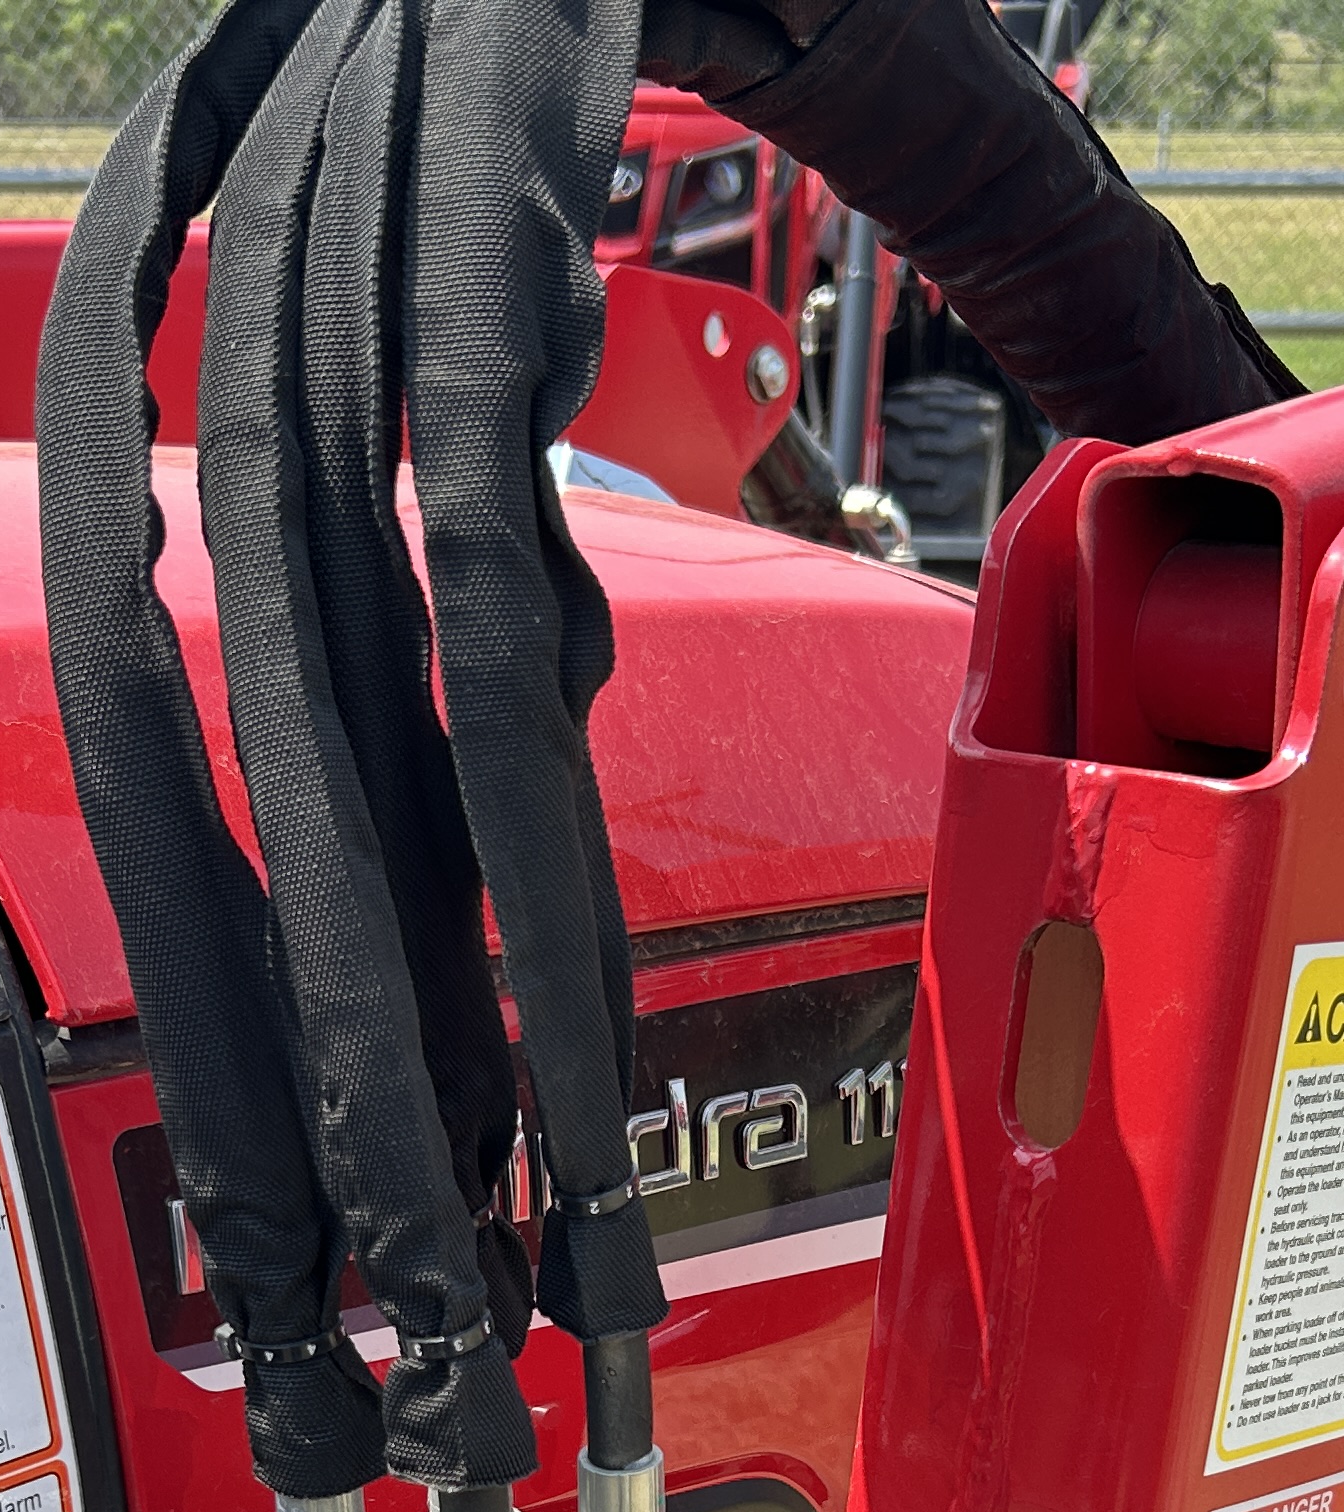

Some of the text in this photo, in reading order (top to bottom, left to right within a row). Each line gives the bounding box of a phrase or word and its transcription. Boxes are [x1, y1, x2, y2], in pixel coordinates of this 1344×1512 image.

[1296, 1073, 1317, 1088] Read
[1316, 1071, 1333, 1086] and
[1276, 1182, 1307, 1200] Operate
[1307, 1180, 1320, 1193] the
[1319, 1176, 1344, 1191] loader
[1273, 1199, 1308, 1217] seat only.
[1257, 1292, 1278, 1306] Keep
[1277, 1285, 1304, 1304] people
[1303, 1281, 1319, 1296] and
[1254, 1306, 1292, 1323] work area.
